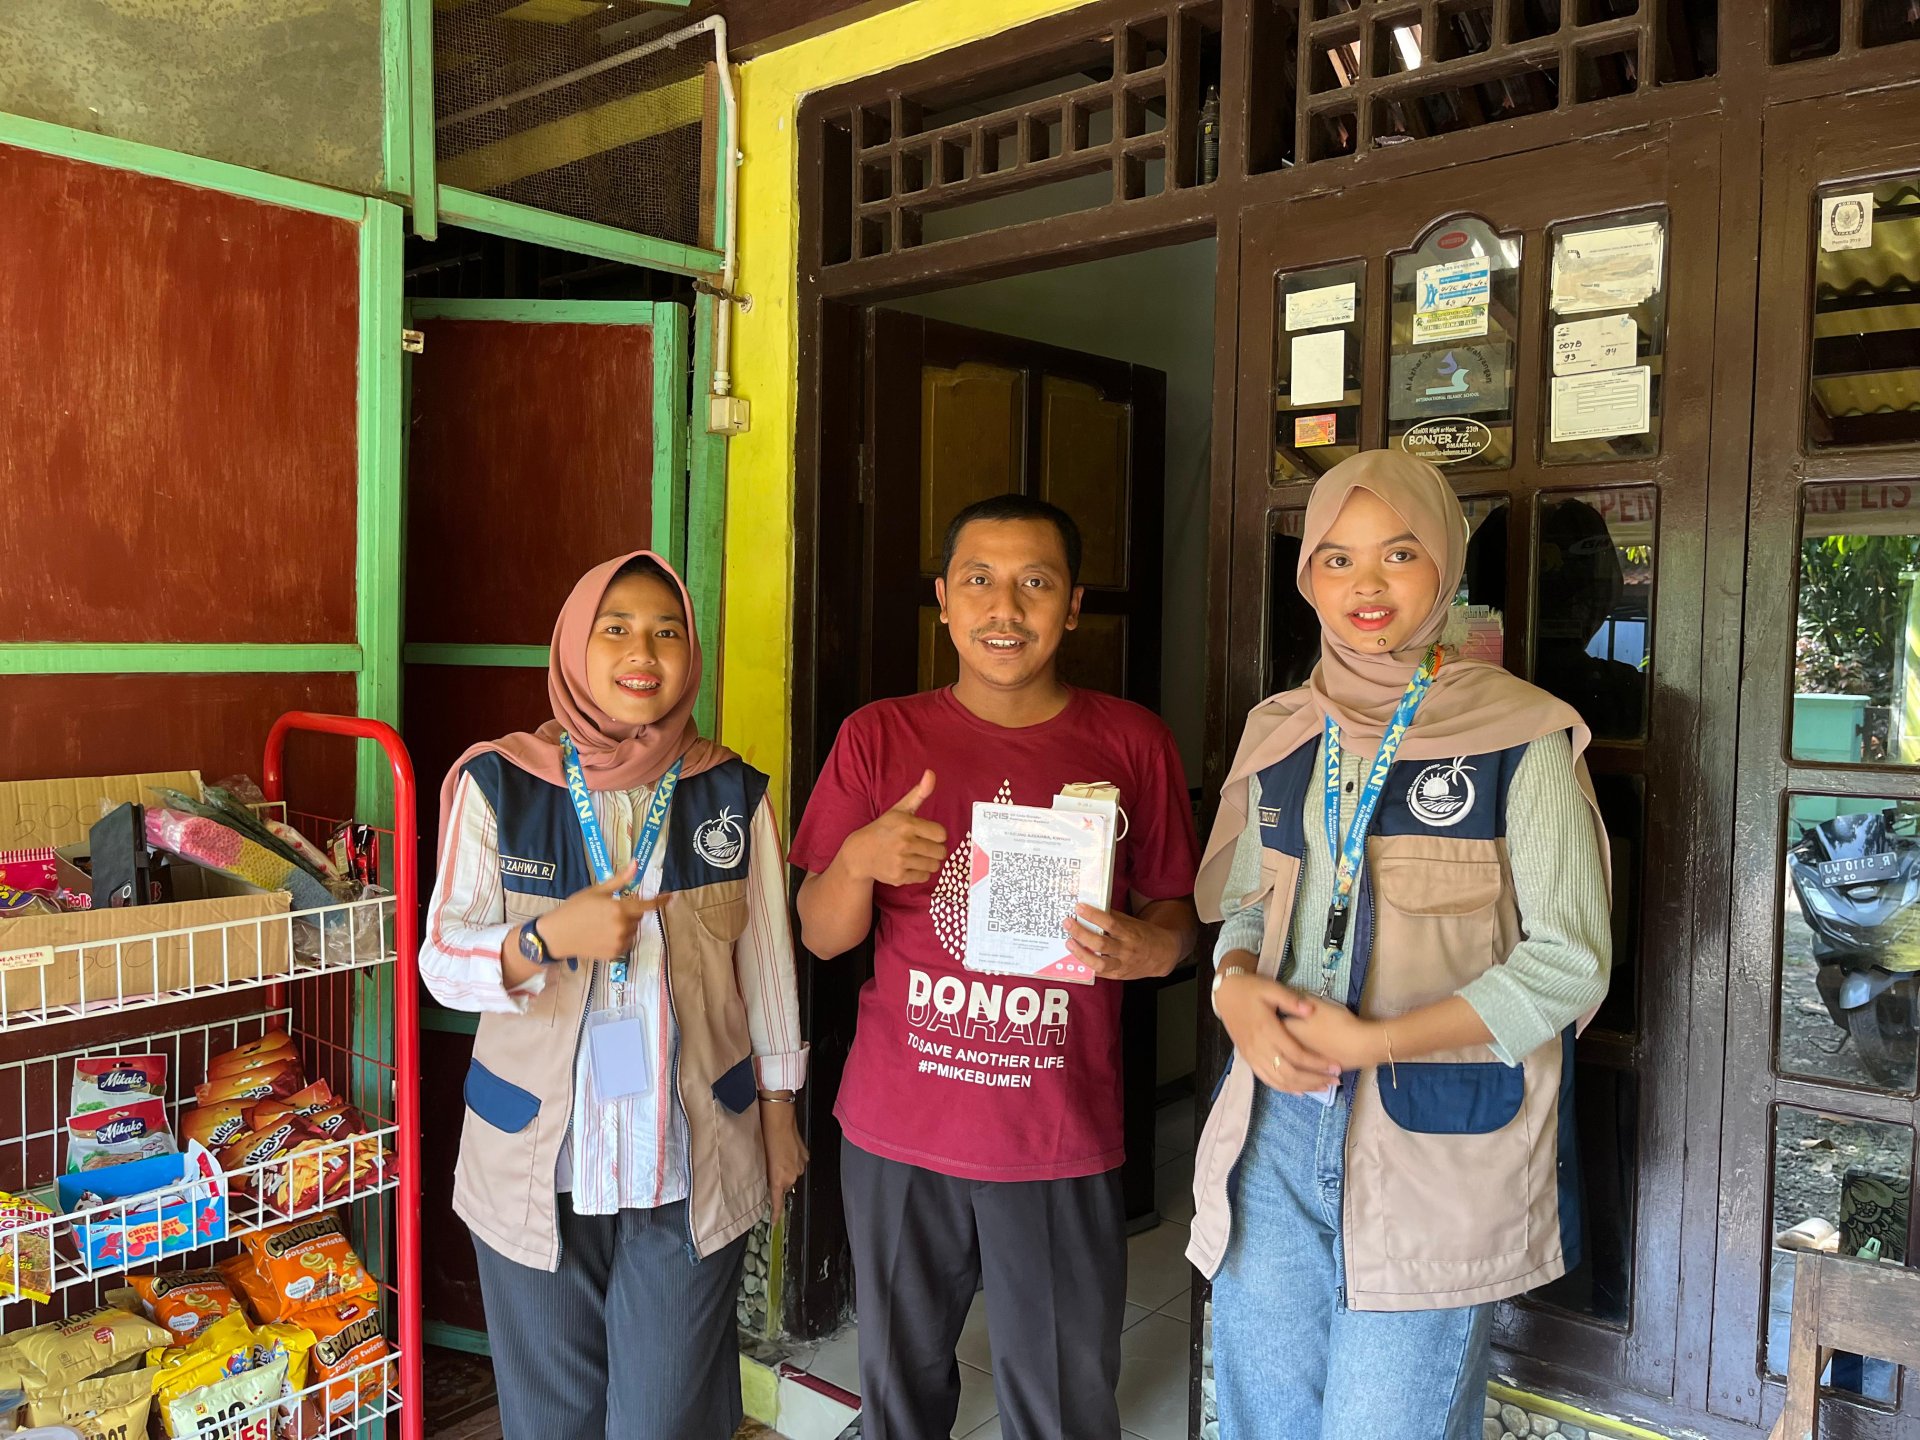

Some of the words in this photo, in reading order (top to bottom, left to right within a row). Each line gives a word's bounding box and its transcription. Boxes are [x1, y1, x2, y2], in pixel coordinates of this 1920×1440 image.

[1408, 434, 1452, 446] BONJER
[1455, 432, 1469, 443] 72
[1328, 725, 1340, 788] KKN
[1370, 724, 1406, 787] KKN
[566, 765, 593, 820] KKN
[648, 771, 677, 825] KKN
[983, 811, 1009, 820] QRIS
[506, 860, 538, 875] ZAHWA
[541, 866, 550, 877] R.
[66, 893, 92, 910] Rolls
[908, 968, 1070, 1025] DONOR
[907, 1032, 918, 1049] TO
[918, 1041, 953, 1058] SAVE
[955, 1048, 1030, 1068] ANOTHER
[1034, 1056, 1065, 1069] LIFE
[101, 1072, 143, 1088] Mikako
[918, 1060, 1032, 1088] #PMIKEBUMEN
[97, 1120, 143, 1142] Mikako
[127, 1218, 180, 1239] CHOCOATE
[284, 1245, 315, 1261] potato
[6, 1260, 33, 1270] SSIS
[169, 1287, 199, 1298] potato
[316, 1313, 382, 1366] CRUNCH
[335, 1354, 359, 1373] potato
[197, 1401, 249, 1440] BIG
